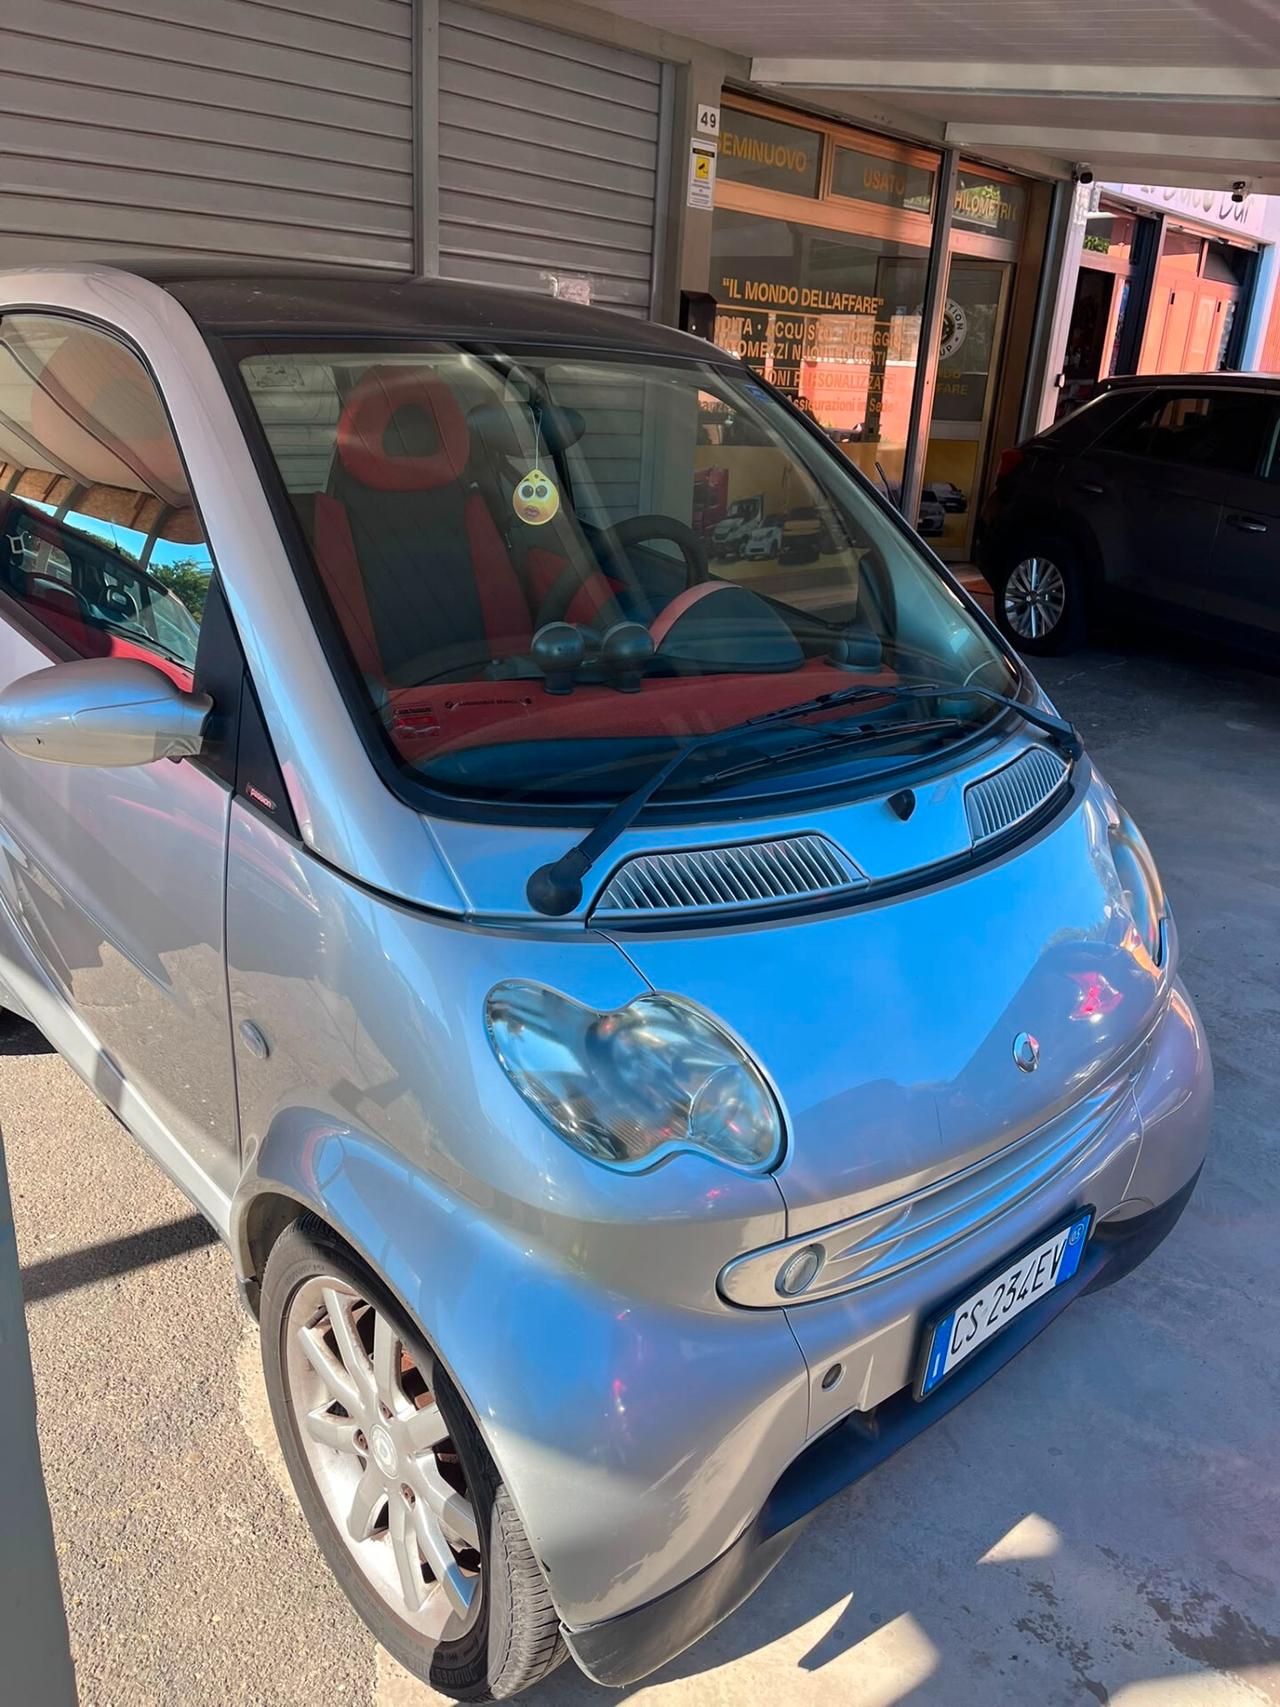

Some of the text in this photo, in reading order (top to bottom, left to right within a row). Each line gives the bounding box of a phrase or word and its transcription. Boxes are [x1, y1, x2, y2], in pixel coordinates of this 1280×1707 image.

[700, 111, 717, 128] 49
[719, 131, 807, 172] EMINUOVO
[863, 168, 906, 195] USATO
[954, 190, 1012, 219] HILOMETRI
[745, 281, 799, 306] MONDO
[945, 301, 964, 330] TION
[765, 320, 832, 342] ACQUISTO
[842, 325, 902, 350] NOLEGGIO
[855, 350, 887, 366] USATI
[939, 344, 953, 357] UP
[793, 371, 895, 391] PERSONALIZZATE
[950, 1238, 1068, 1356] CS 234EV
[931, 1352, 942, 1379] I
